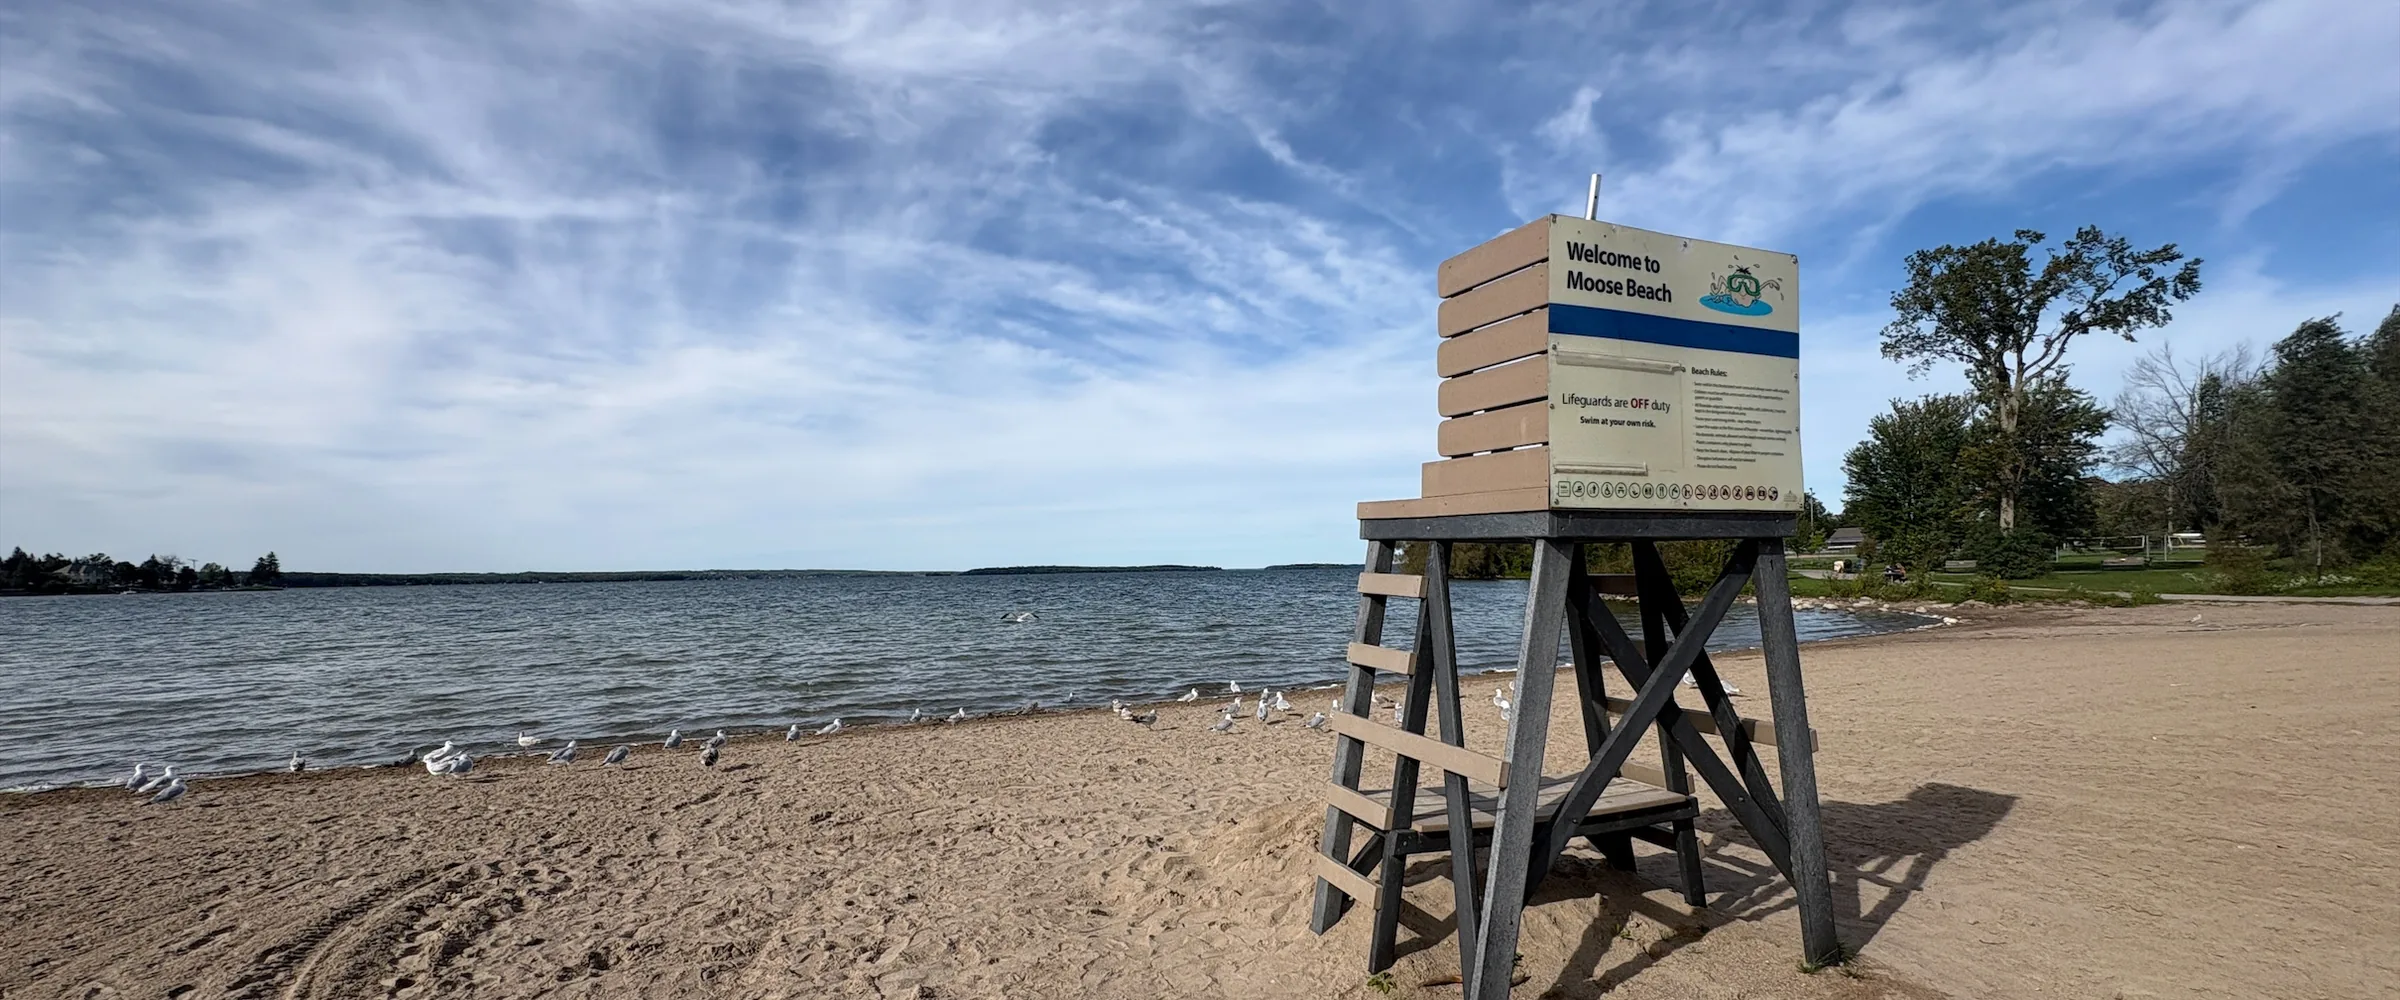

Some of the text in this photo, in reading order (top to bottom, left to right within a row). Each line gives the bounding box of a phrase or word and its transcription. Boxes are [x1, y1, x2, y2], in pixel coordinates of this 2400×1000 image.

[1566, 241, 1660, 273] Welcome to
[1567, 270, 1672, 303] Moose Beach
[1691, 366, 1709, 375] Beach
[1562, 393, 1670, 414] Lifeguards are OFF duty
[1580, 416, 1600, 425] Swim
[1601, 417, 1608, 425] at
[1609, 419, 1625, 427] your
[1642, 419, 1656, 428] risk.
